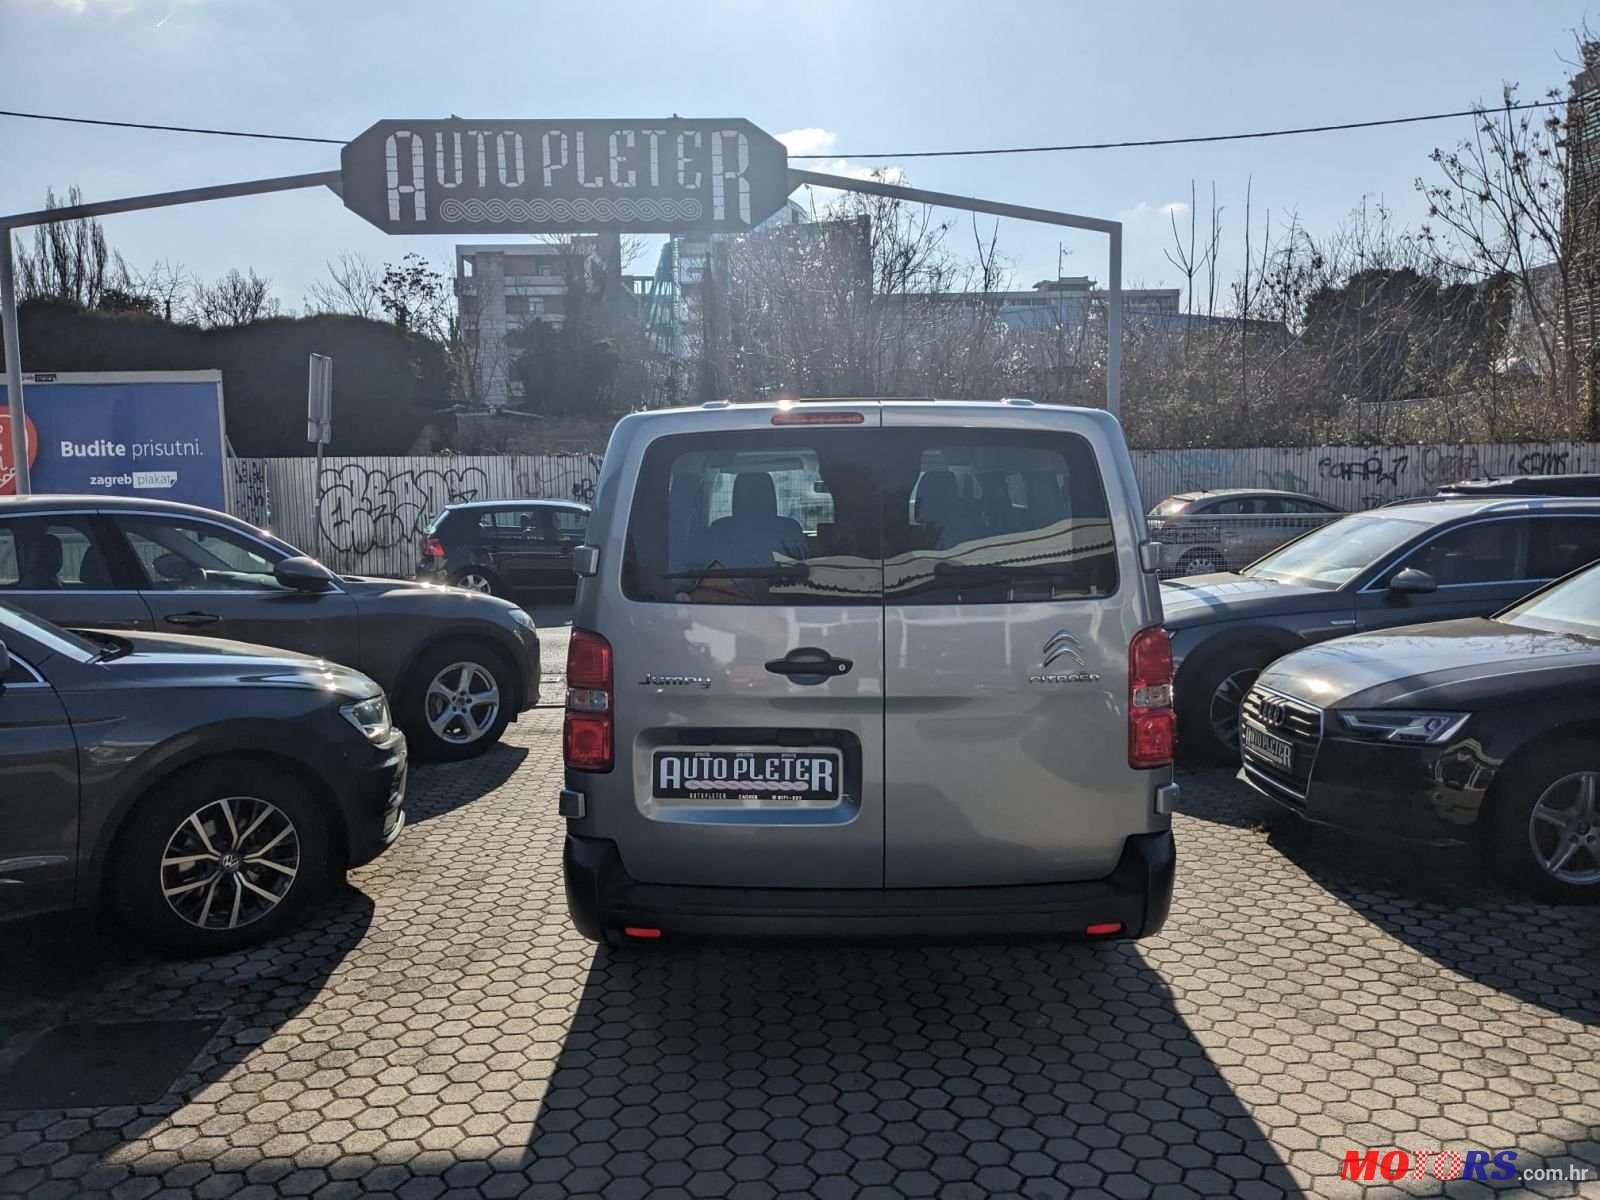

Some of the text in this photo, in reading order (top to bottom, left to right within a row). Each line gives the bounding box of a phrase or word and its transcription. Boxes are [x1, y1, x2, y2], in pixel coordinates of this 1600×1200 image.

[385, 130, 751, 224] AUTO PLETER
[61, 438, 204, 460] Budite prisutni.
[90, 471, 172, 487] zagreb plakat
[660, 756, 833, 792] AUTO PLETER
